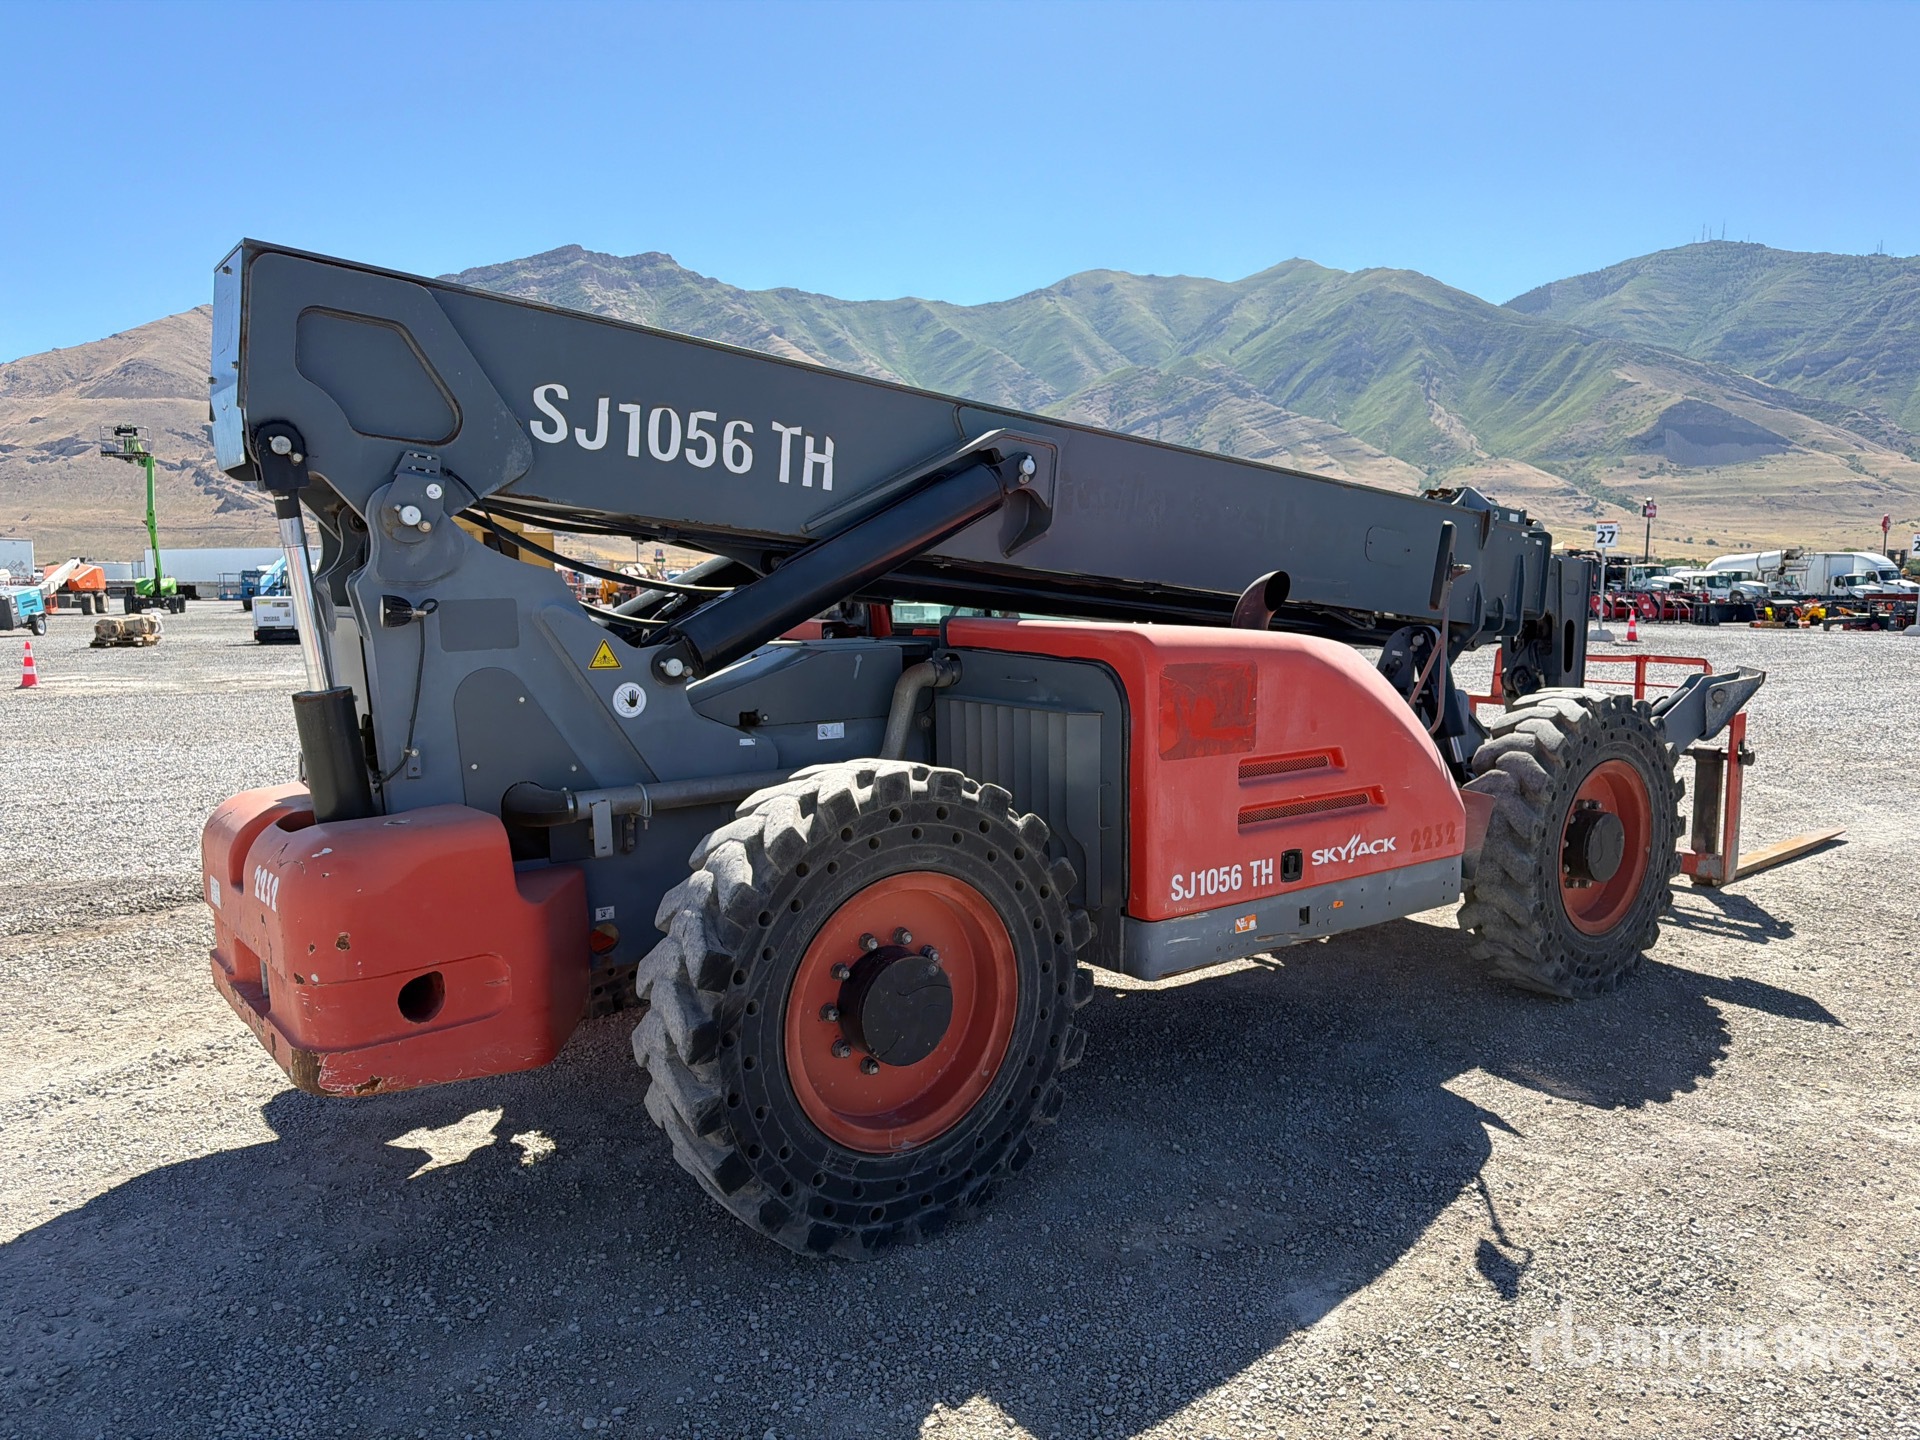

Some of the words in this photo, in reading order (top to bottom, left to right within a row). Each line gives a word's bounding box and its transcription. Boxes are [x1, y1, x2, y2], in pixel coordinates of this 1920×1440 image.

[529, 383, 754, 474] SJ1056
[771, 420, 835, 491] TH
[1596, 530, 1616, 544] 27
[1913, 540, 1920, 552] 2
[1311, 833, 1397, 864] SKYJACK
[1170, 864, 1243, 902] SJ1056
[1249, 858, 1274, 888] TH
